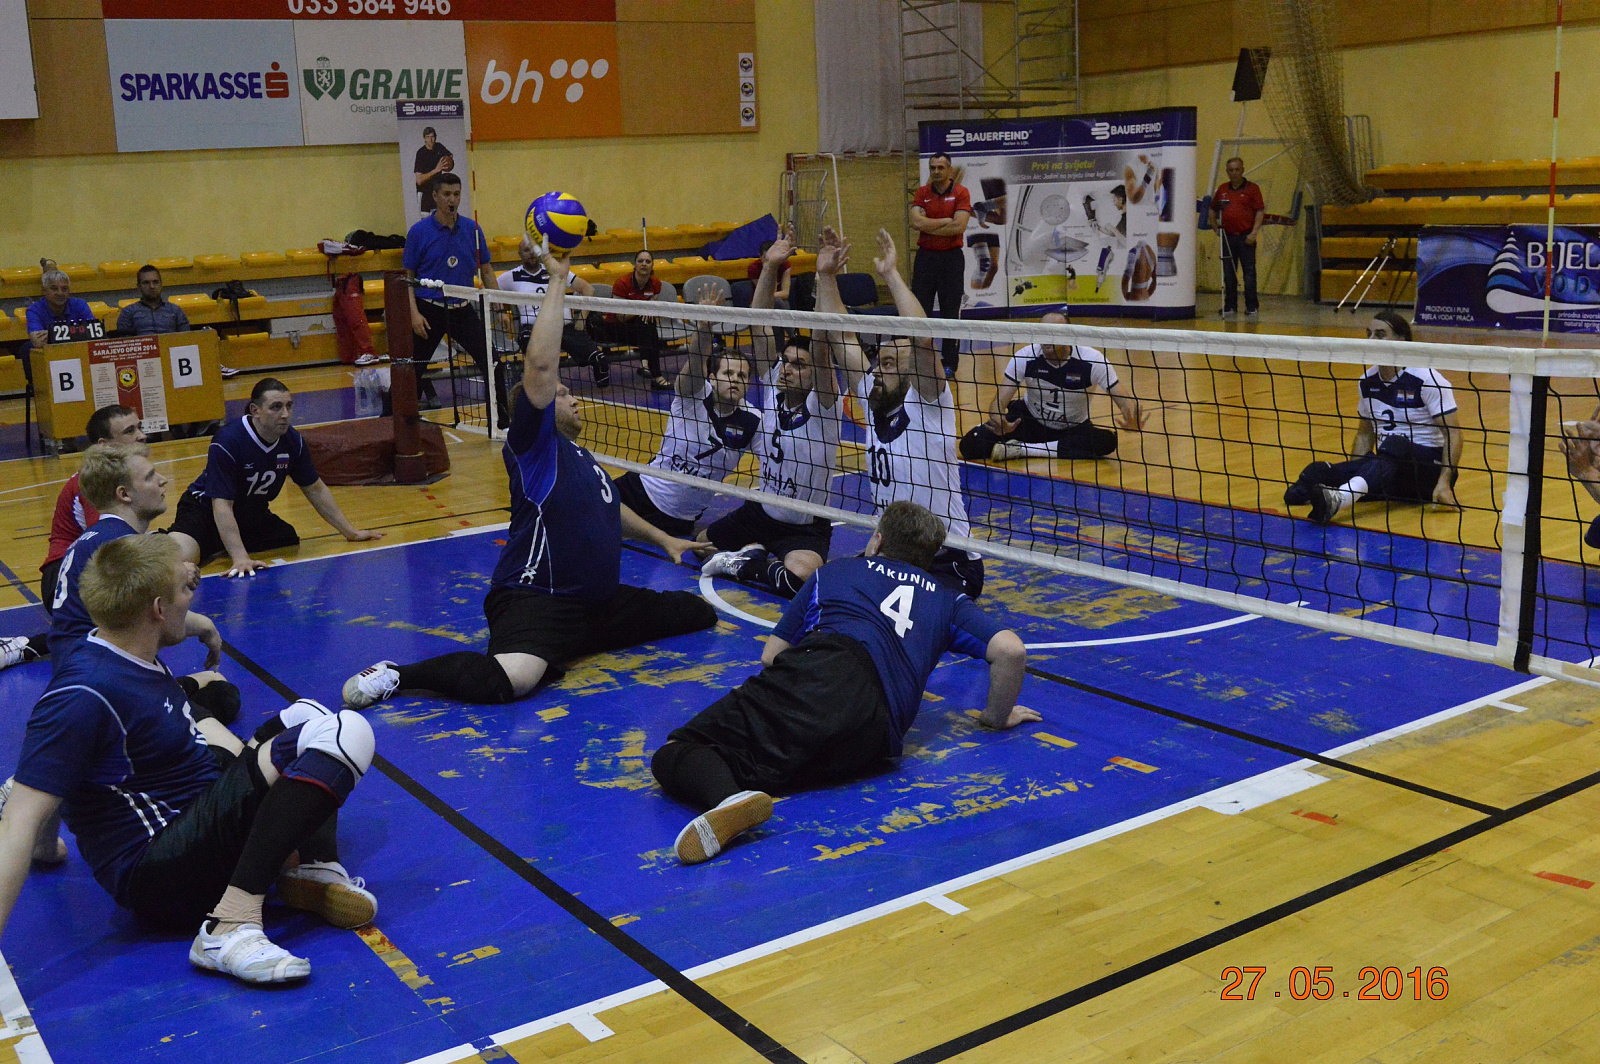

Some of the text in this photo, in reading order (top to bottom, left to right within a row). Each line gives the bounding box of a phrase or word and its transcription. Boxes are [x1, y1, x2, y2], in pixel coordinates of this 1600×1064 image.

[287, 0, 452, 15] 033 584 946
[119, 71, 263, 102] SPARKASSE
[349, 68, 464, 101] GRAWE
[481, 59, 544, 104] bh
[415, 104, 457, 112] BAUERFEIND
[966, 129, 1030, 142] BAUERFEIND
[1110, 121, 1162, 136] BAUERFEIND
[1031, 161, 1050, 171] Prvi
[1065, 159, 1097, 171] svijetu!
[1527, 241, 1600, 274] BJEL
[1533, 273, 1600, 295] VOD
[53, 324, 71, 341] 22
[86, 322, 103, 338] 15
[92, 347, 125, 356] SARAJEVO
[177, 357, 193, 377] B
[59, 372, 75, 391] B
[1381, 409, 1397, 431] 3
[694, 435, 724, 461] 7
[868, 445, 891, 488] 10
[246, 470, 277, 497] 12
[592, 464, 614, 504] 3
[866, 559, 936, 593] YAKUNIN
[879, 584, 915, 639] 4
